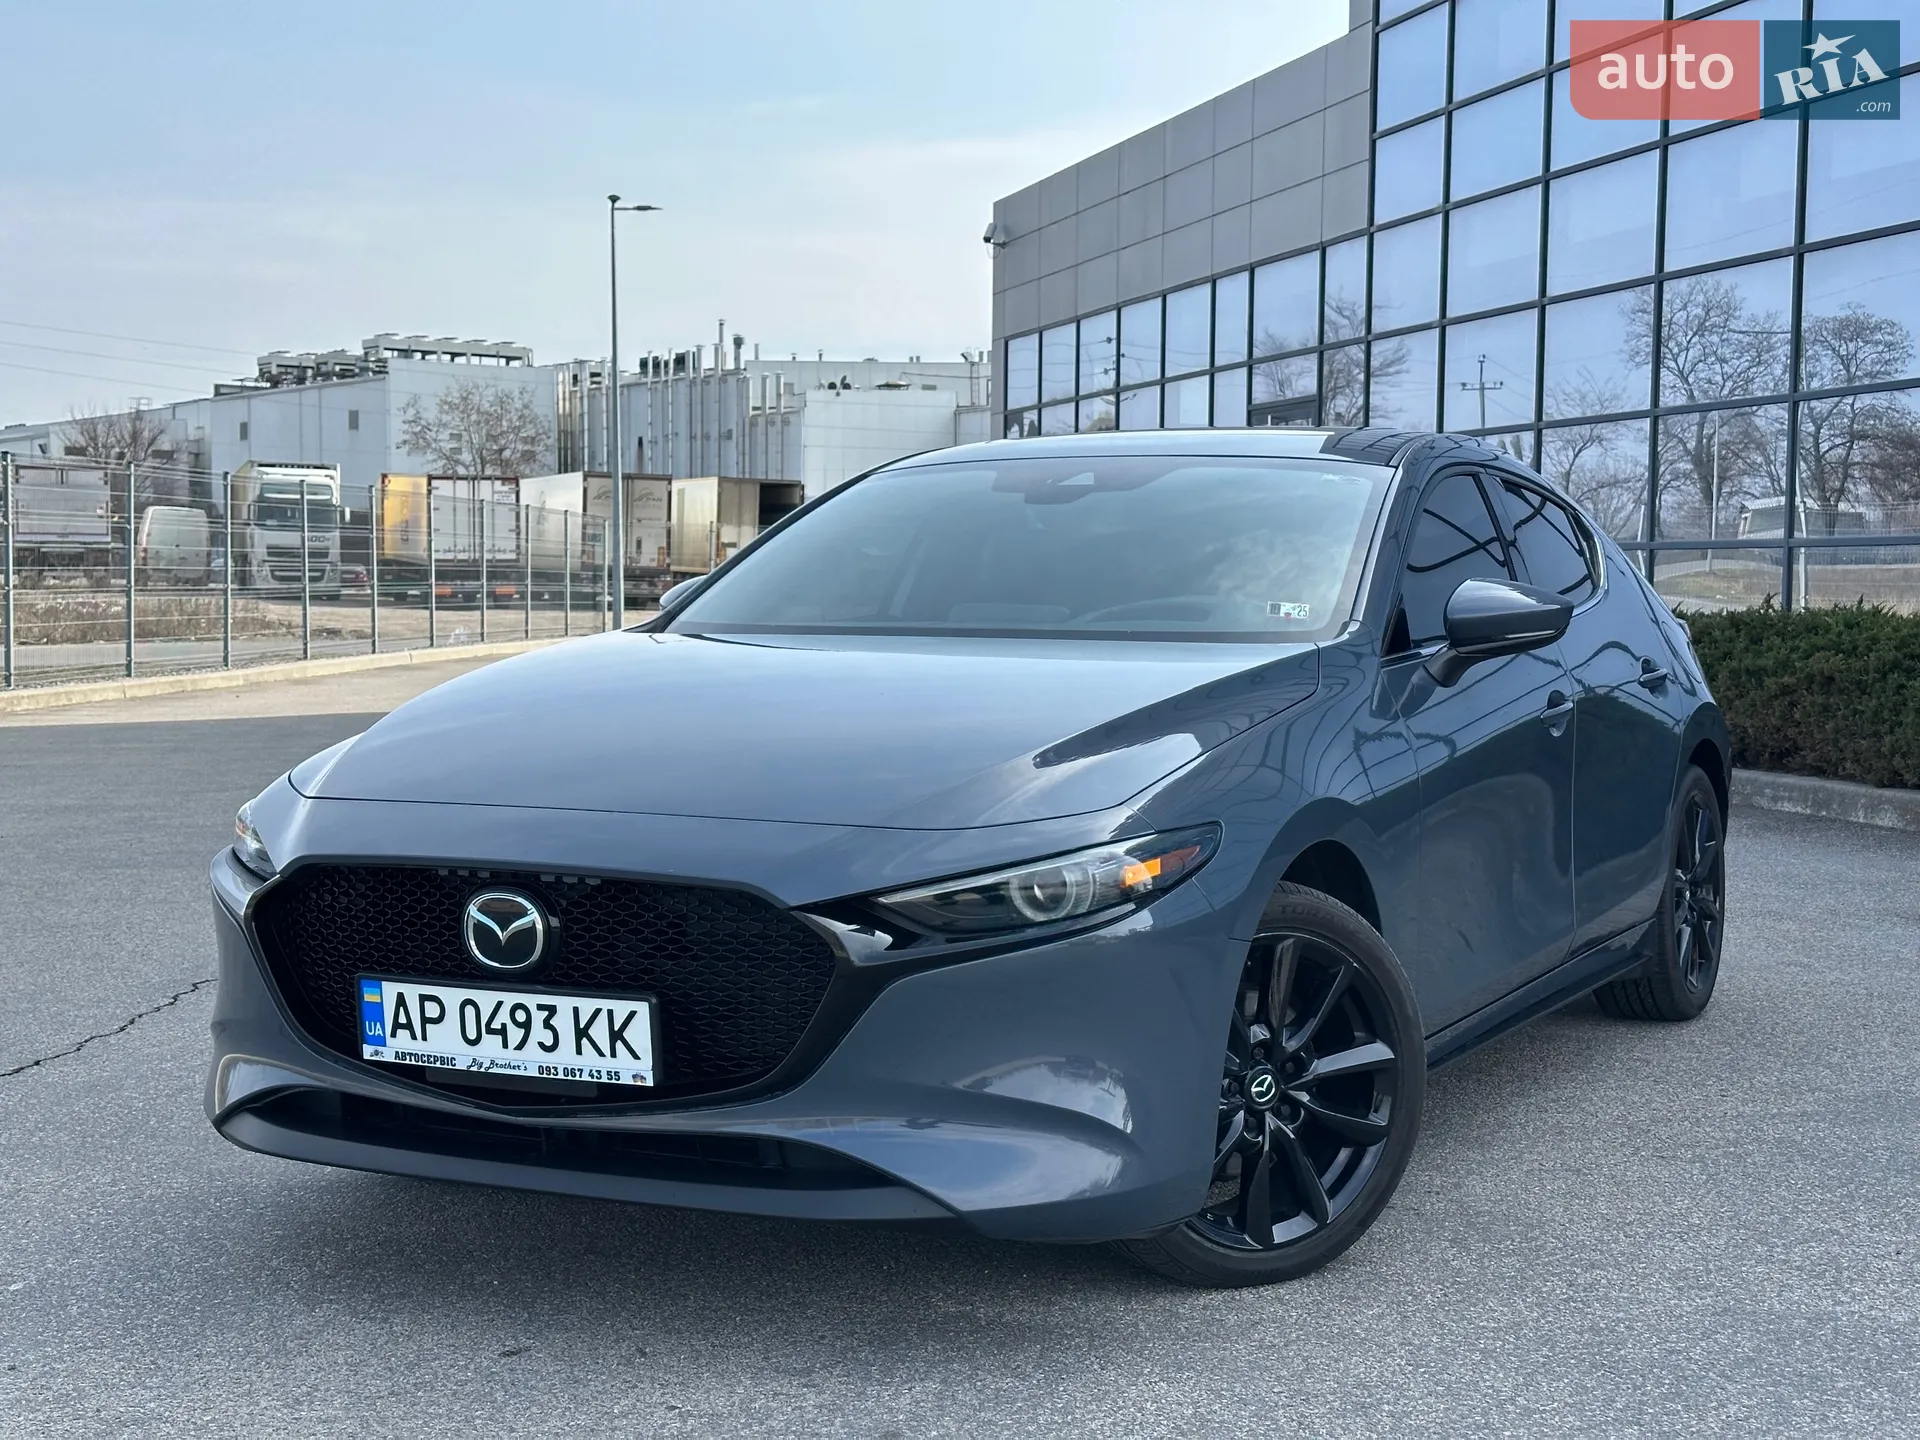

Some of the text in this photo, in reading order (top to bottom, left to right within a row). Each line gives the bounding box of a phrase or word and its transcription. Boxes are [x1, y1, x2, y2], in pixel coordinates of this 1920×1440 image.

[366, 1021, 383, 1037] UA
[389, 991, 642, 1061] AP 0493 KK
[394, 1050, 456, 1067] АВТОСЕРВІС
[466, 1057, 528, 1072] Big Brother's
[537, 1064, 621, 1082] 093 067 43 55
